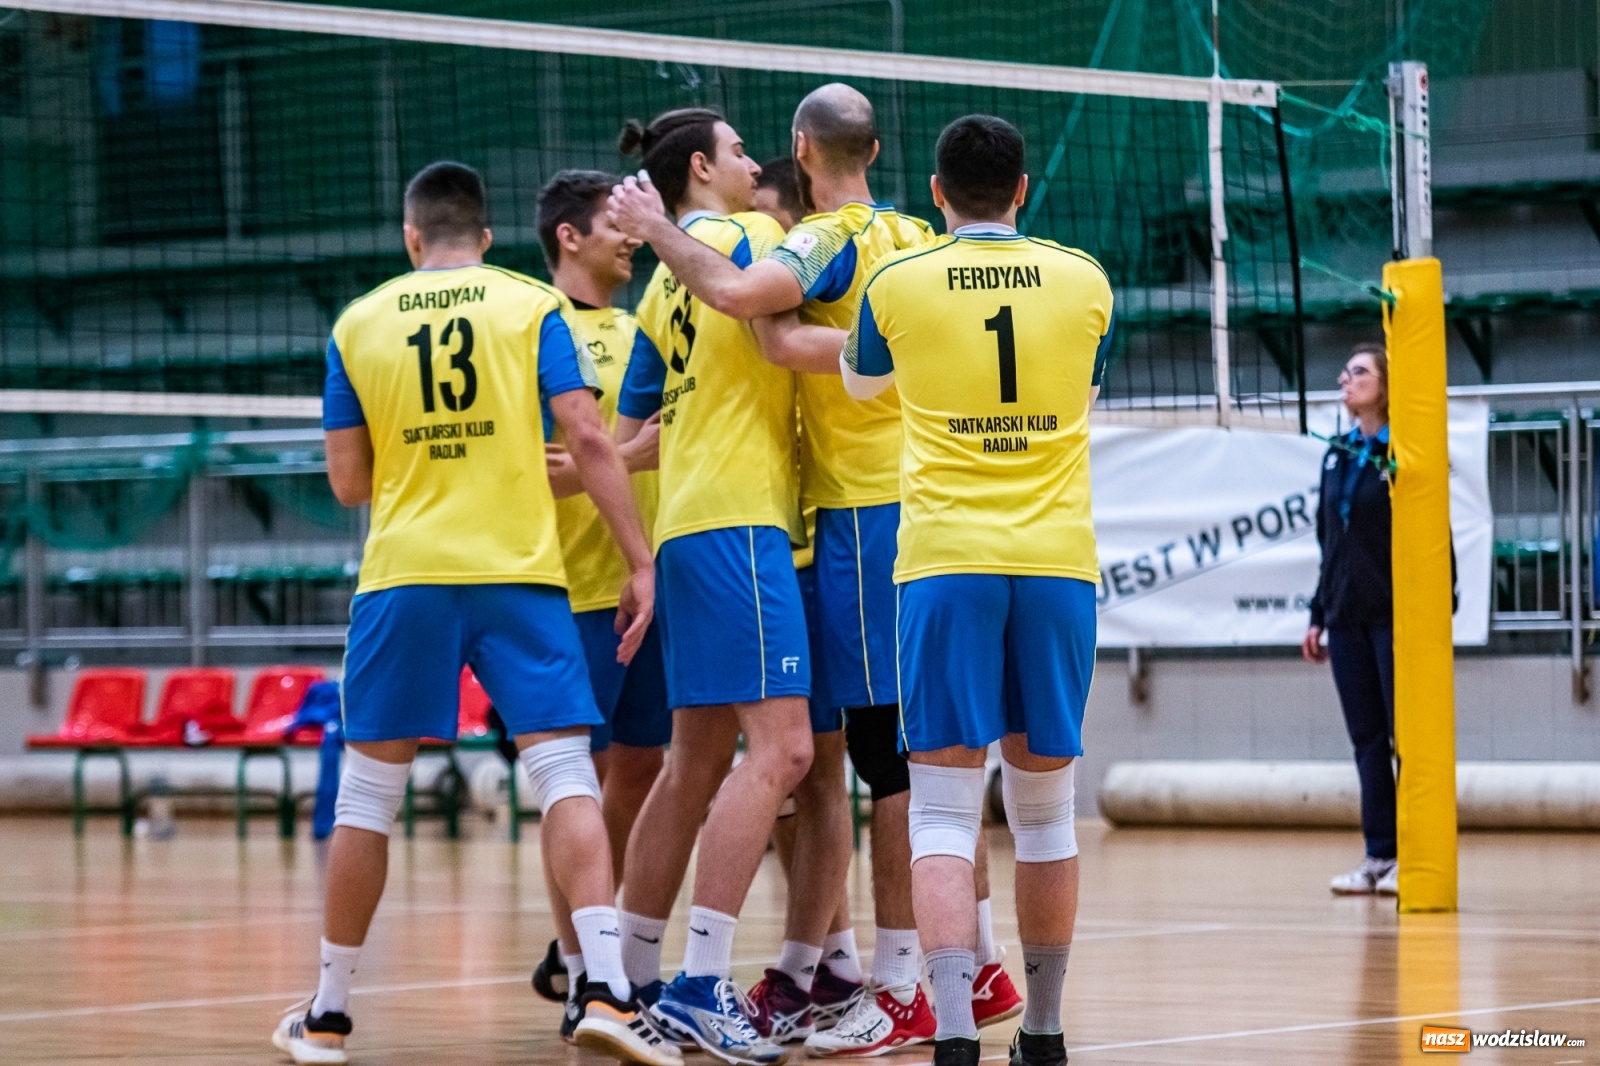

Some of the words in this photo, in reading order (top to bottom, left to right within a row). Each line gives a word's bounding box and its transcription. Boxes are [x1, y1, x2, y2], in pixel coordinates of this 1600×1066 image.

[947, 266, 1042, 290] FERDYAN
[399, 286, 486, 312] GARDYAN
[407, 316, 478, 414] 13
[984, 305, 1018, 404] 1
[465, 420, 495, 437] KLUB
[948, 416, 1024, 434] SIATKARSKI
[1027, 415, 1058, 431] KLUB
[429, 443, 467, 460] RADLIN
[983, 437, 1028, 453] RADLIN
[1187, 524, 1221, 569] W
[1231, 486, 1320, 549] POR
